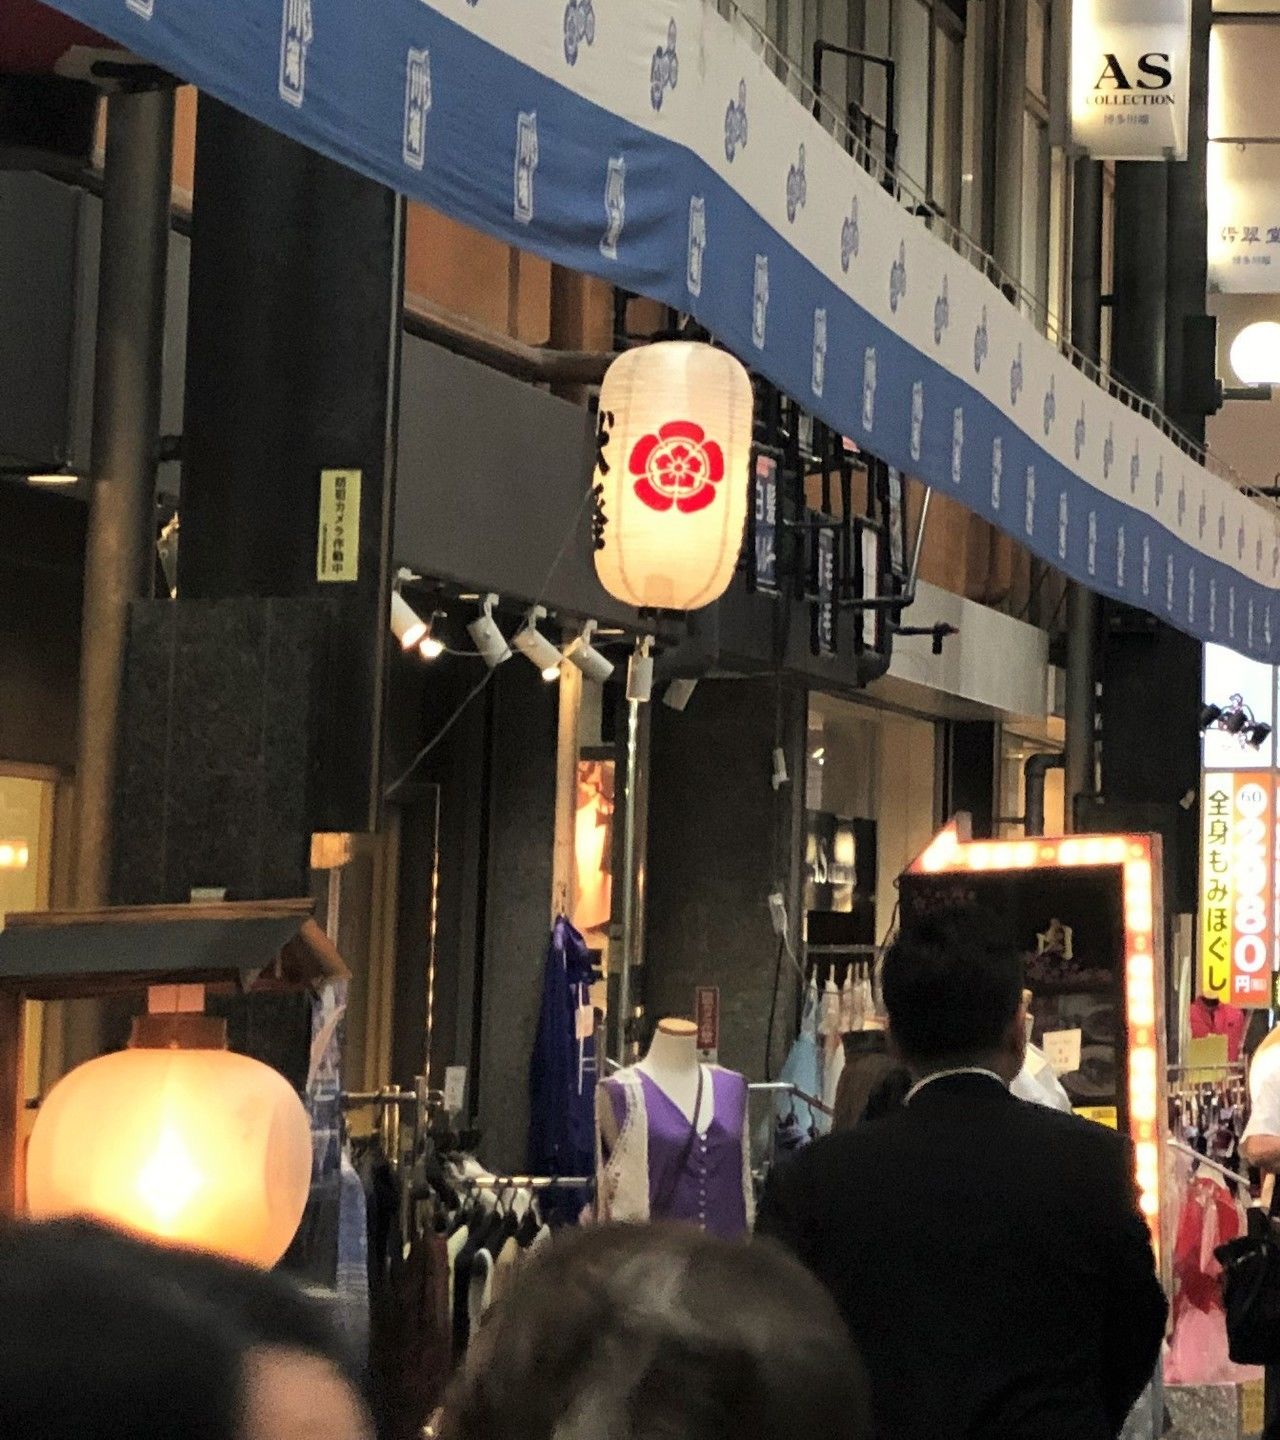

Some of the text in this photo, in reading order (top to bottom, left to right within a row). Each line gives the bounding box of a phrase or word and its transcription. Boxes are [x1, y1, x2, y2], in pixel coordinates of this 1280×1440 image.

[1094, 52, 1172, 90] AS
[1207, 790, 1230, 992] 全身もみほぐし
